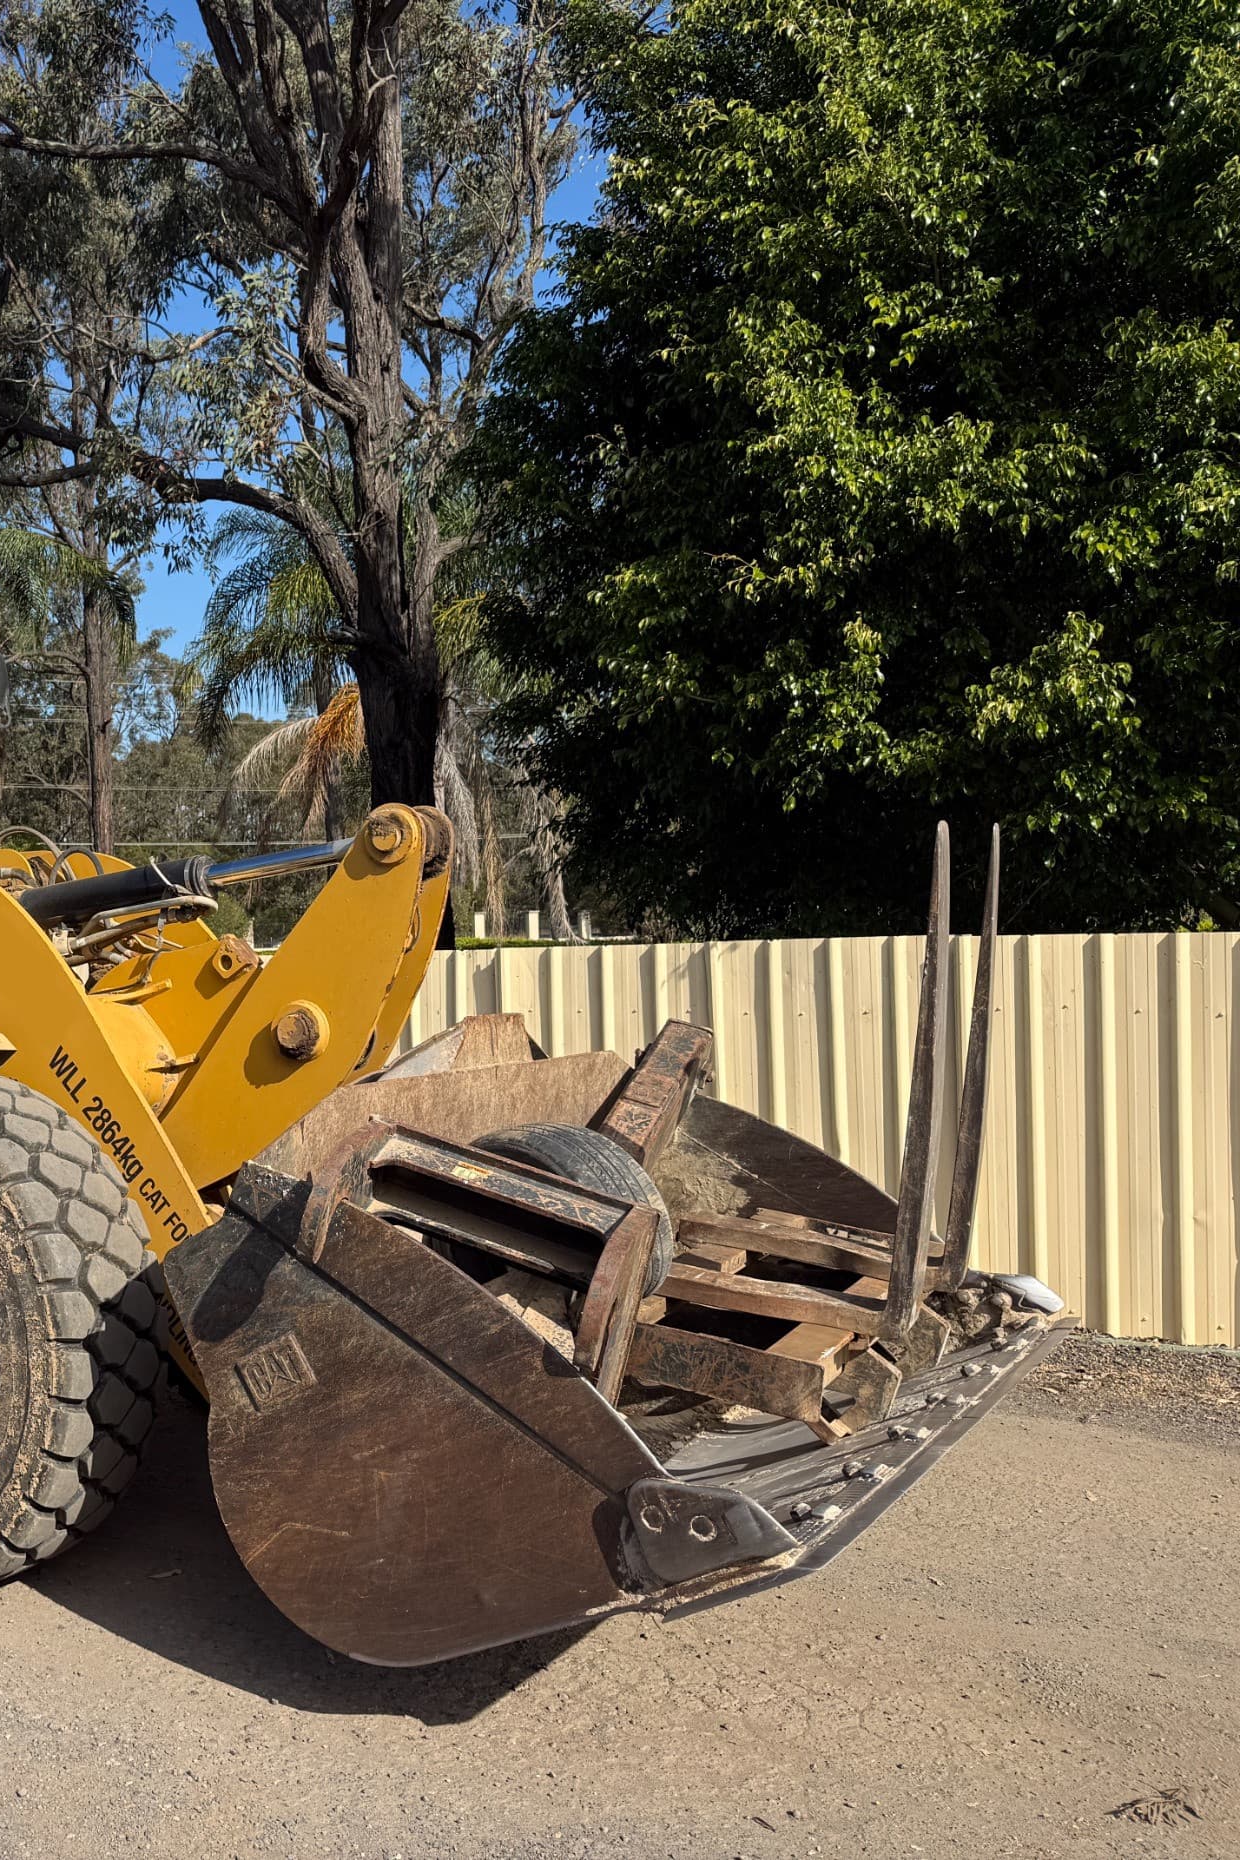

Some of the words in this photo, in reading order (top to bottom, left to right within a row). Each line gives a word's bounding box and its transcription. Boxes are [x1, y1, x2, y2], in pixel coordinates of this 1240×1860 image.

[48, 1045, 87, 1104] WLL
[82, 1096, 144, 1184] 2864kg
[139, 1178, 171, 1215] CAT
[163, 1211, 192, 1242] FO
[244, 1343, 303, 1401] CAT
